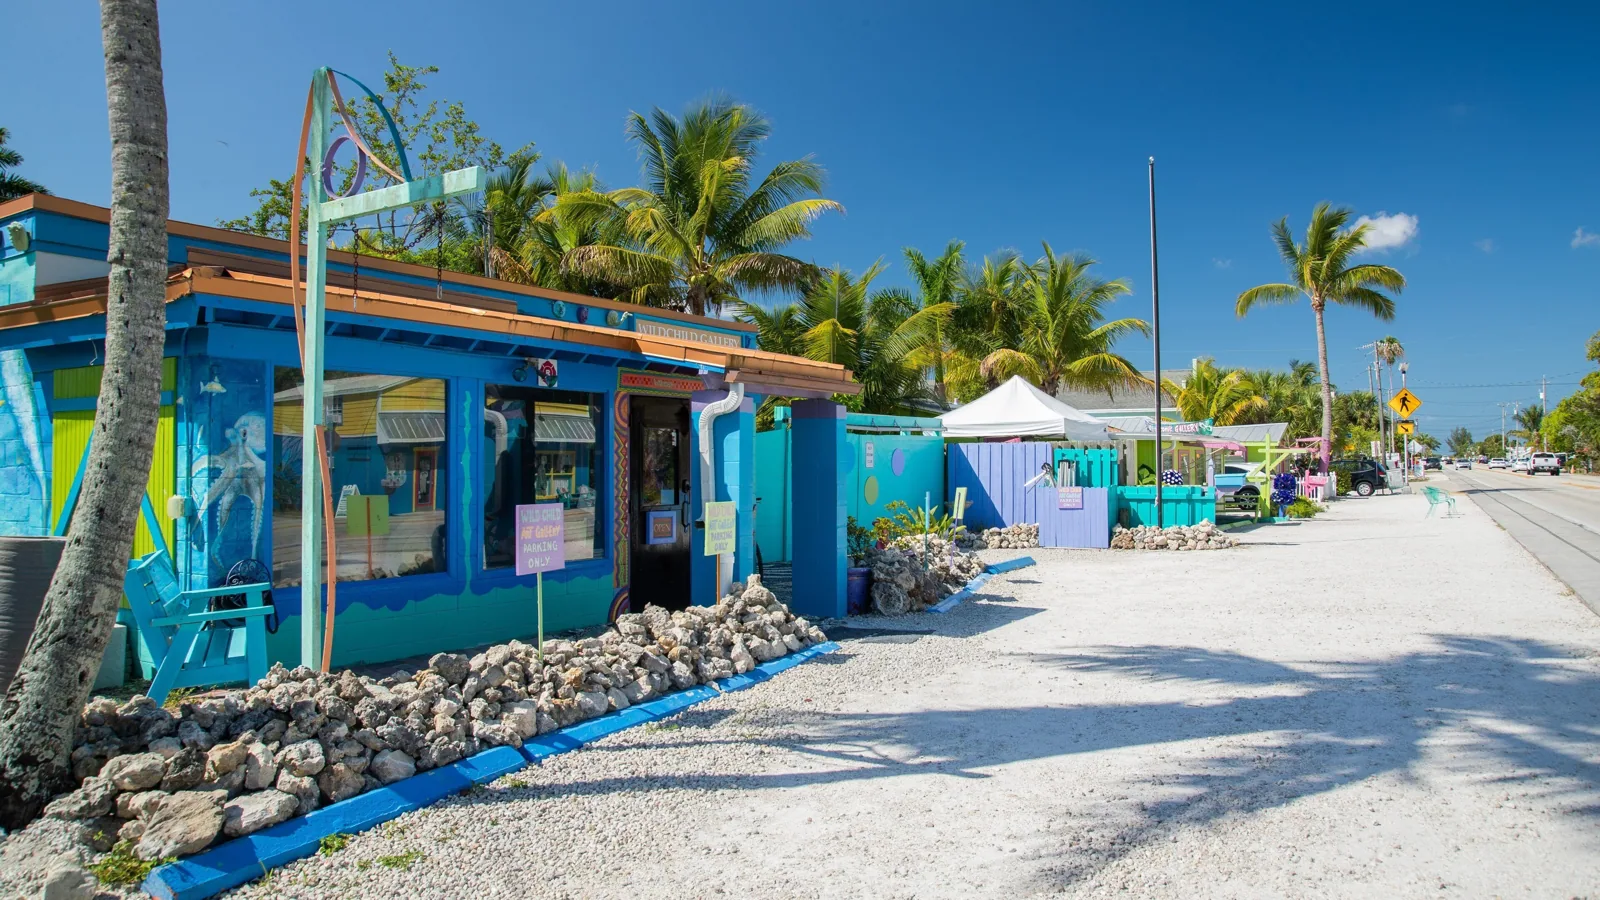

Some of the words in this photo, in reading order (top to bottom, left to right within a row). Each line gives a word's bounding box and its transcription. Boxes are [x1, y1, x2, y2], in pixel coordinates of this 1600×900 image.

[638, 323, 698, 341] WILDCHILD
[700, 333, 740, 348] GALLERY
[520, 508, 540, 523] WILD
[710, 530, 733, 542] PARKING
[523, 541, 558, 554] PARKING
[714, 542, 729, 552] ONLY
[528, 556, 551, 569] ONLY
